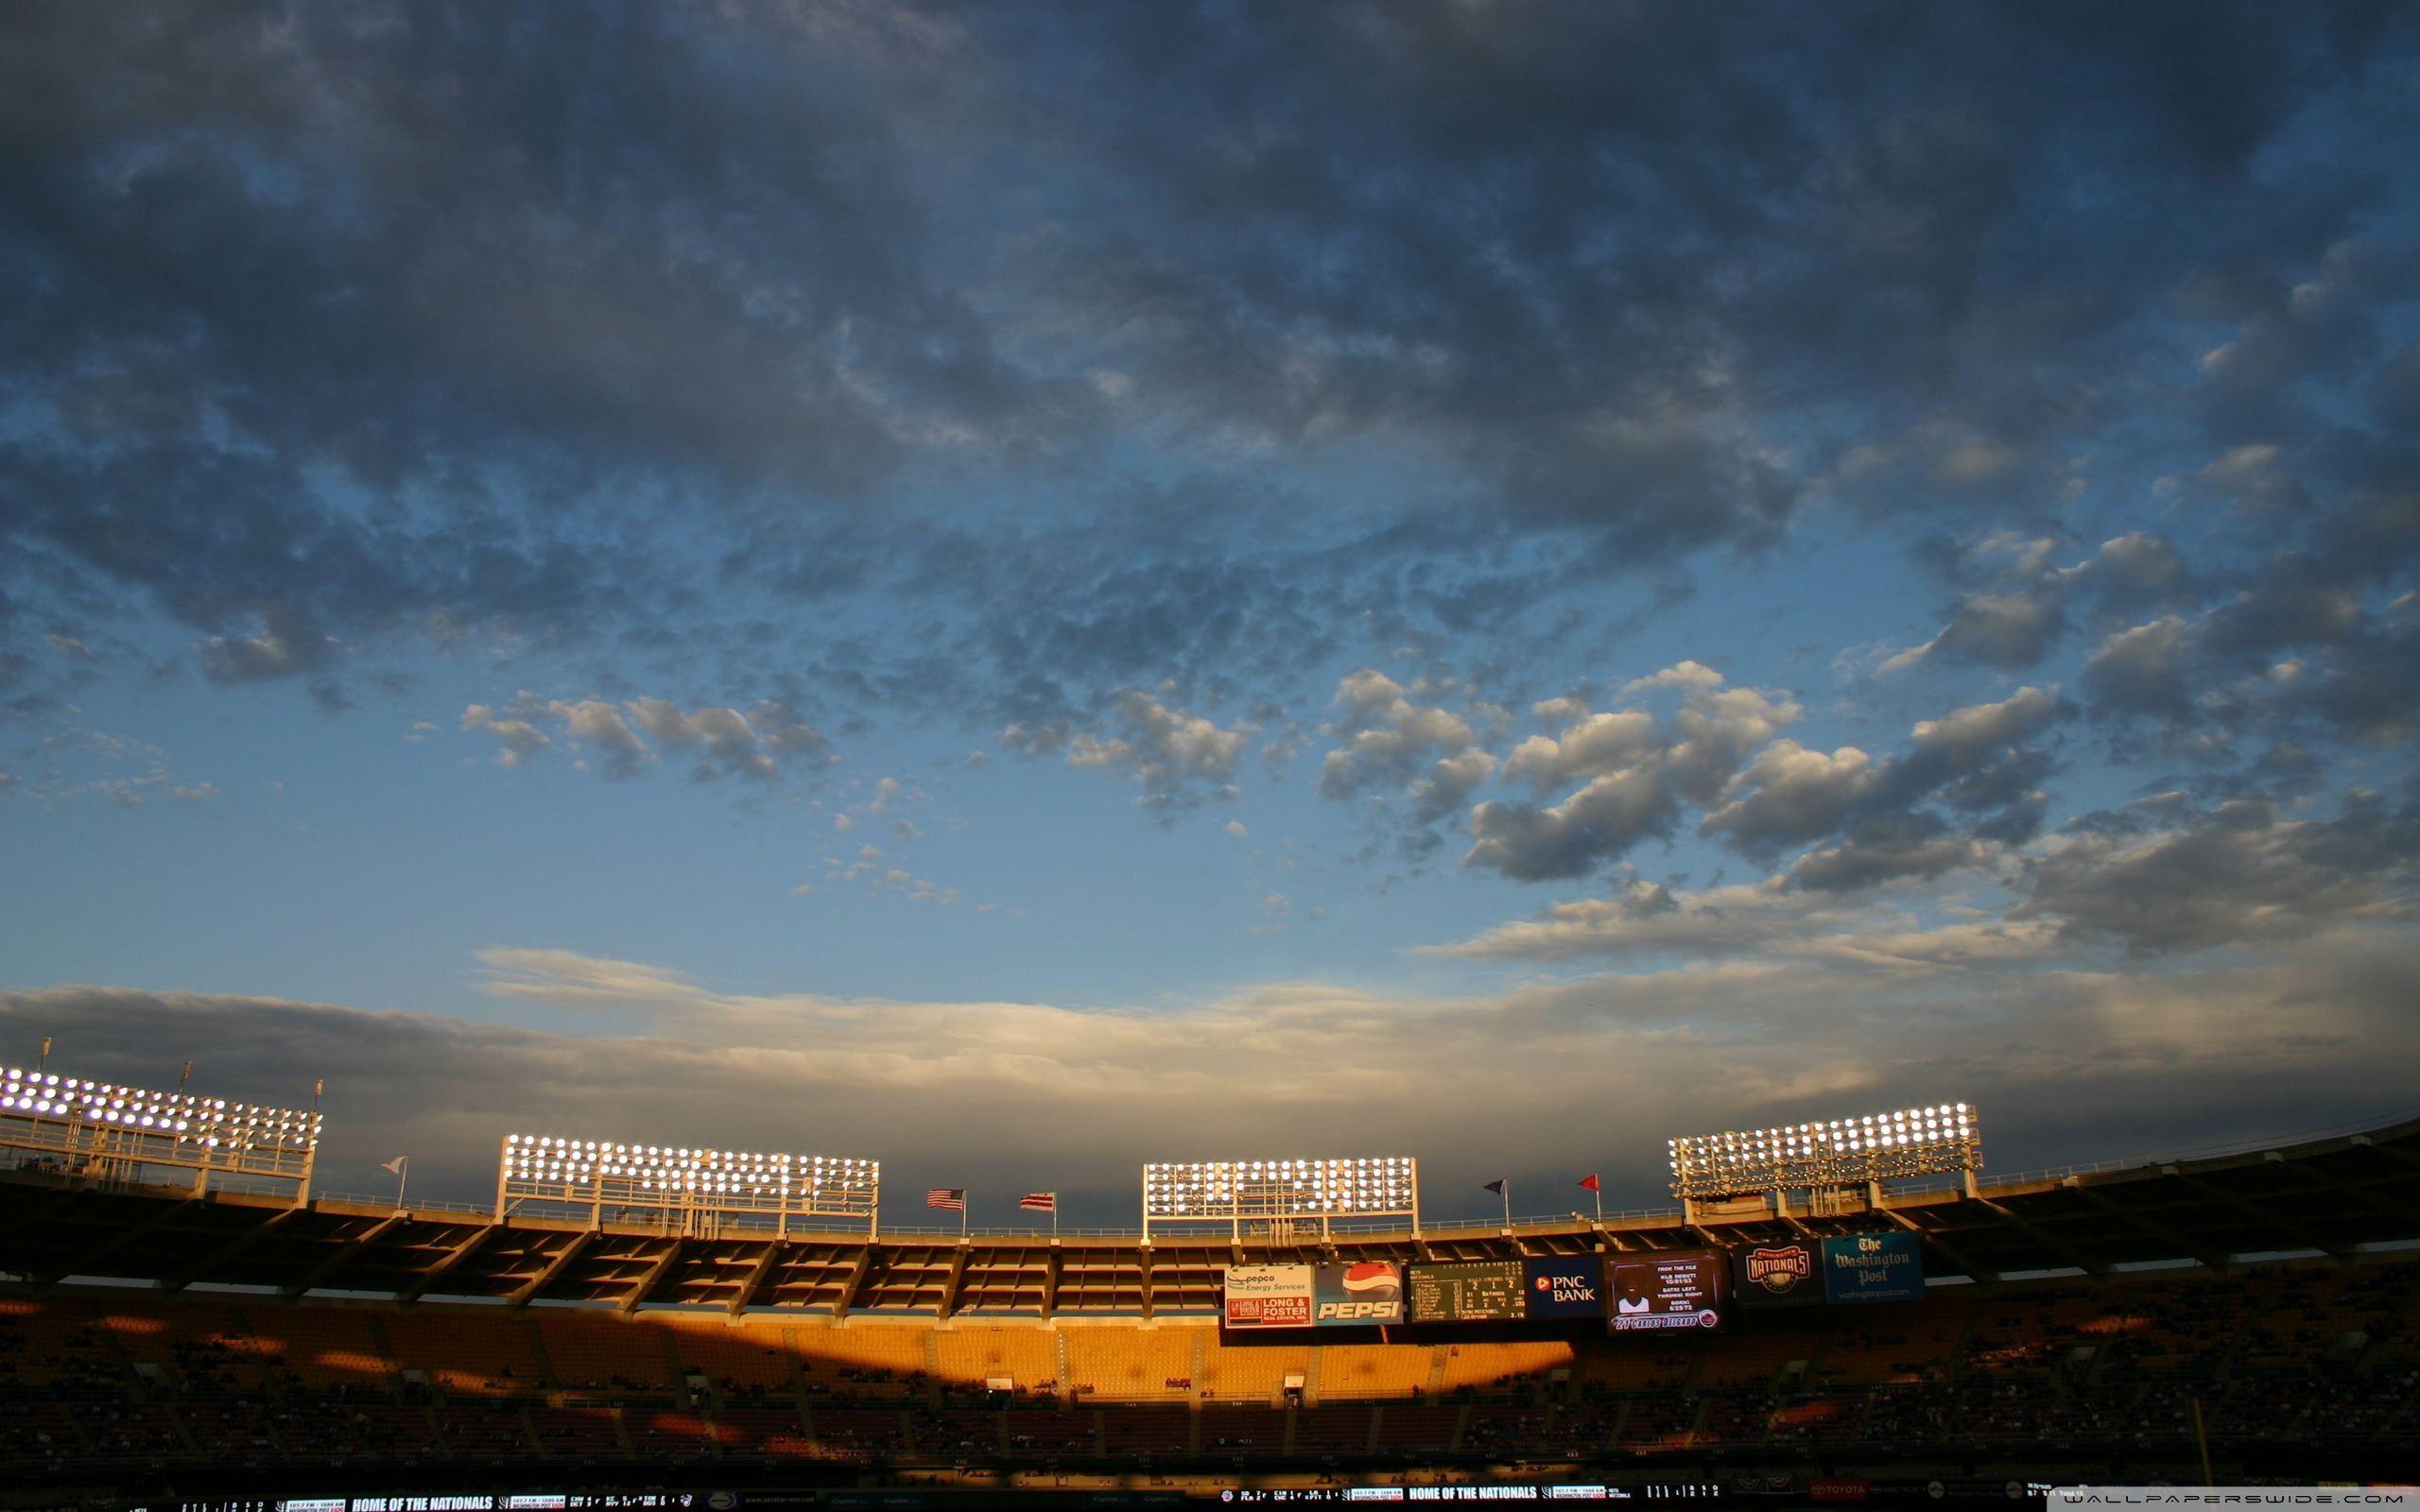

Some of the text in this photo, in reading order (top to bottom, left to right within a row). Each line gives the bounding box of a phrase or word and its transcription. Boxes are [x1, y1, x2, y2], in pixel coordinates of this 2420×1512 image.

[1858, 1237, 1883, 1253] The
[1751, 1255, 1806, 1279] NATIONALS
[1834, 1252, 1911, 1269] Washington
[1246, 1276, 1275, 1284] pepco
[1552, 1275, 1585, 1289] PNC
[1858, 1269, 1889, 1286] Post
[1273, 1283, 1305, 1292] Services
[1552, 1288, 1597, 1302] BANK
[1263, 1298, 1305, 1308] LONG &
[1263, 1307, 1307, 1317] FOSTER
[1317, 1301, 1399, 1320] PEPSI
[1409, 1486, 1537, 1500] HOME OF THE NATIONALS
[1825, 1485, 1865, 1494] TOYOTA
[352, 1496, 493, 1512] HOME OF THE NATIONALS
